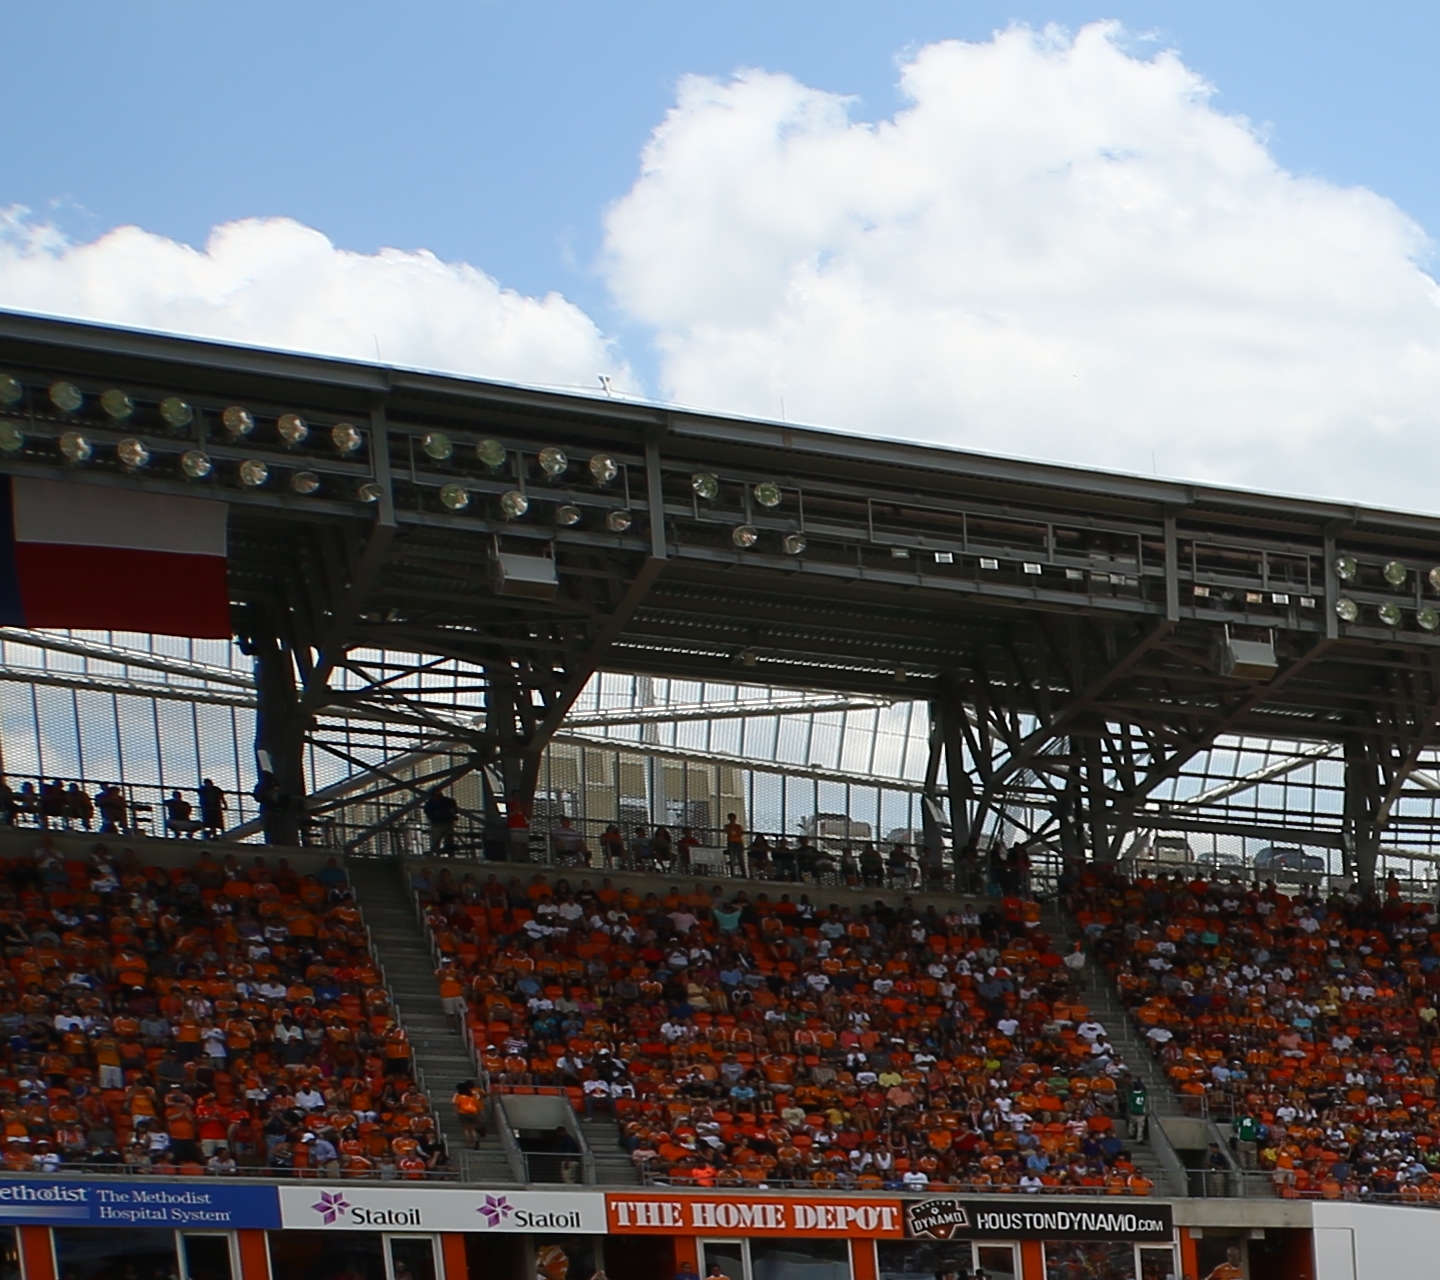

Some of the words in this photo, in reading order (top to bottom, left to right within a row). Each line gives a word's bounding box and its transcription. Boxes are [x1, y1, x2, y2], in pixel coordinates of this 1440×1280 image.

[0, 1184, 87, 1202] ethodist
[97, 1189, 128, 1203] The
[132, 1190, 212, 1204] Methodist
[99, 1205, 168, 1222] Hospital
[171, 1208, 230, 1225] System
[351, 1207, 421, 1226] Statoil
[515, 1209, 581, 1229] Statoil
[611, 1201, 684, 1227] THE
[692, 1203, 786, 1229] HOME
[793, 1204, 897, 1231] DEPOT
[914, 1211, 965, 1233] DYNAMO
[977, 1212, 1163, 1232] HOUSTONDYNAMO.COM
